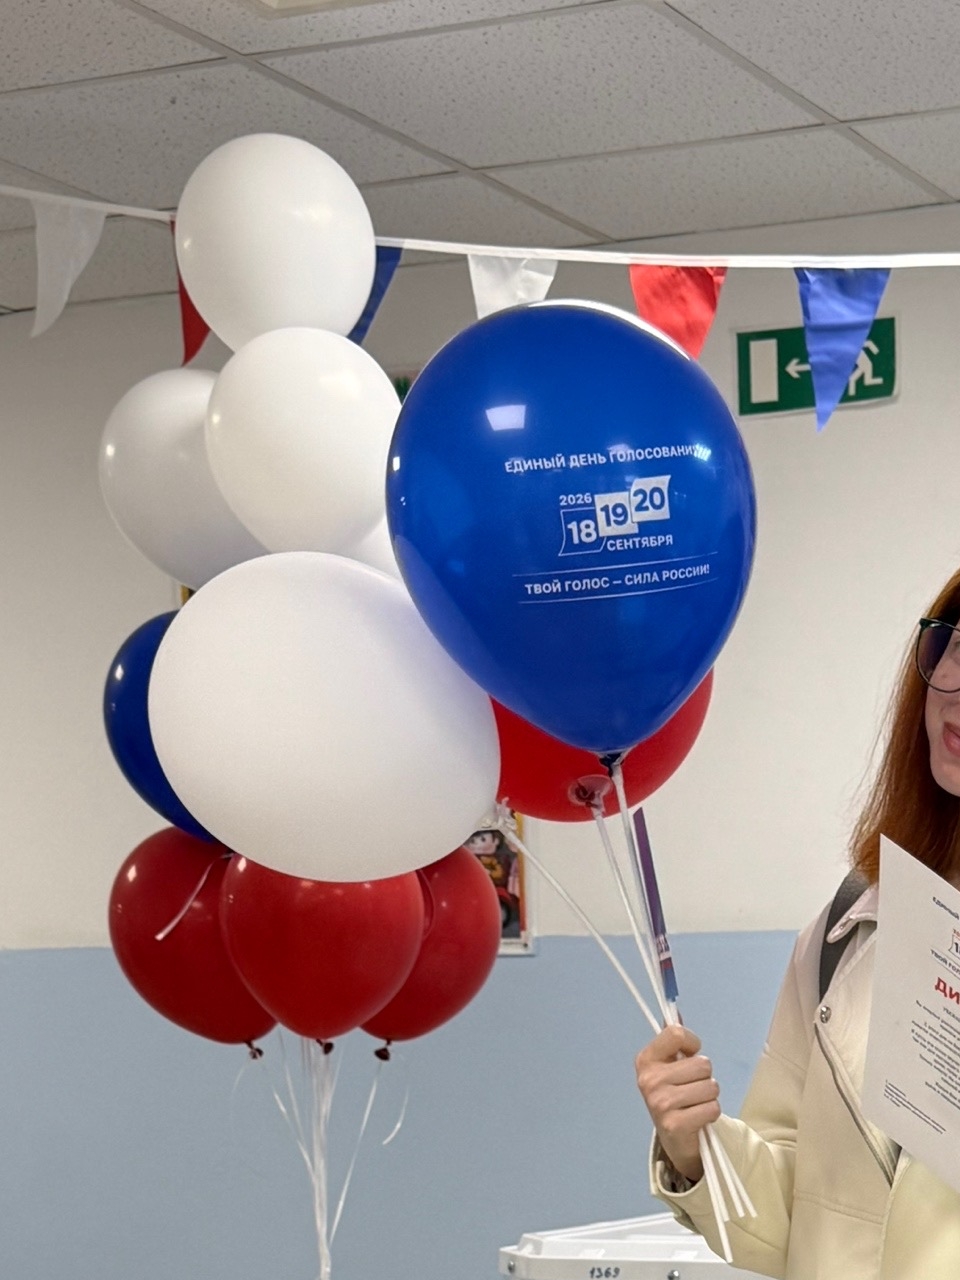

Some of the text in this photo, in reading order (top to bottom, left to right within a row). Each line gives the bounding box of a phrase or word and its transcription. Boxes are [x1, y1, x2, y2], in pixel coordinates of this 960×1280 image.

[504, 444, 701, 474] ЕДИНЫЙ ДЕНЬ ГОЛОСОВАНИ
[558, 492, 593, 506] 2026
[566, 486, 666, 545] 18 19 20
[606, 534, 674, 552] СЕНТЯБРЯ
[524, 578, 562, 596] ТВОЙ
[564, 576, 610, 592] ГОЛОС
[624, 571, 660, 586] СИЛА
[662, 563, 710, 582] РОССИИ!
